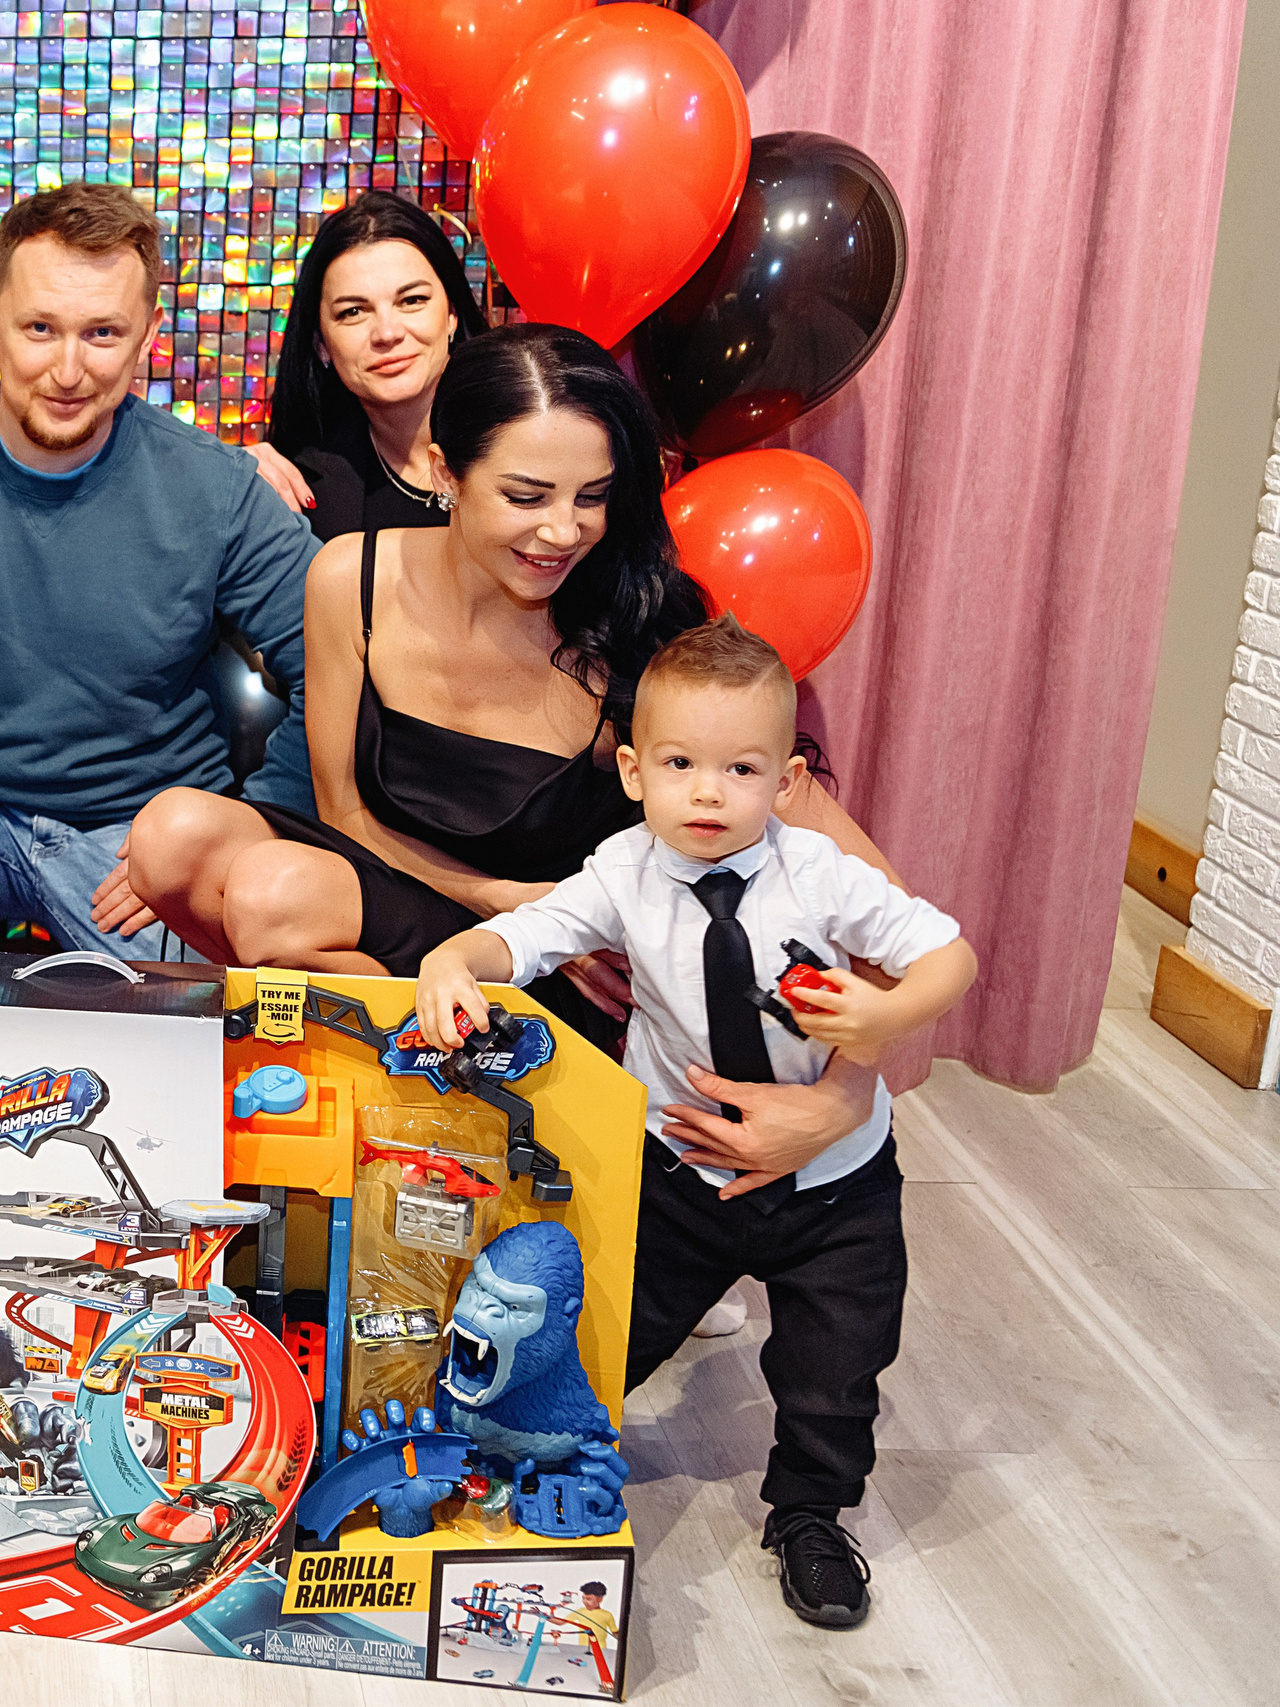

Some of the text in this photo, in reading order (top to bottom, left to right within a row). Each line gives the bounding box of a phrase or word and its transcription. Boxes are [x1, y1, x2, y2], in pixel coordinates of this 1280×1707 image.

[261, 990, 301, 1000] TRY ME
[261, 1002, 299, 1013] ESSAIE
[266, 1012, 293, 1021] -MOI
[125, 1215, 140, 1227] 3
[129, 1290, 145, 1301] 2
[161, 1393, 210, 1409] METAL
[161, 1404, 210, 1420] MACHINES
[298, 1555, 394, 1582] GORILLA
[294, 1582, 417, 1609] RAMPAGE!
[242, 1643, 261, 1656] 4+
[292, 1633, 338, 1652] WARNING:
[362, 1640, 416, 1660] ATTENTION:
